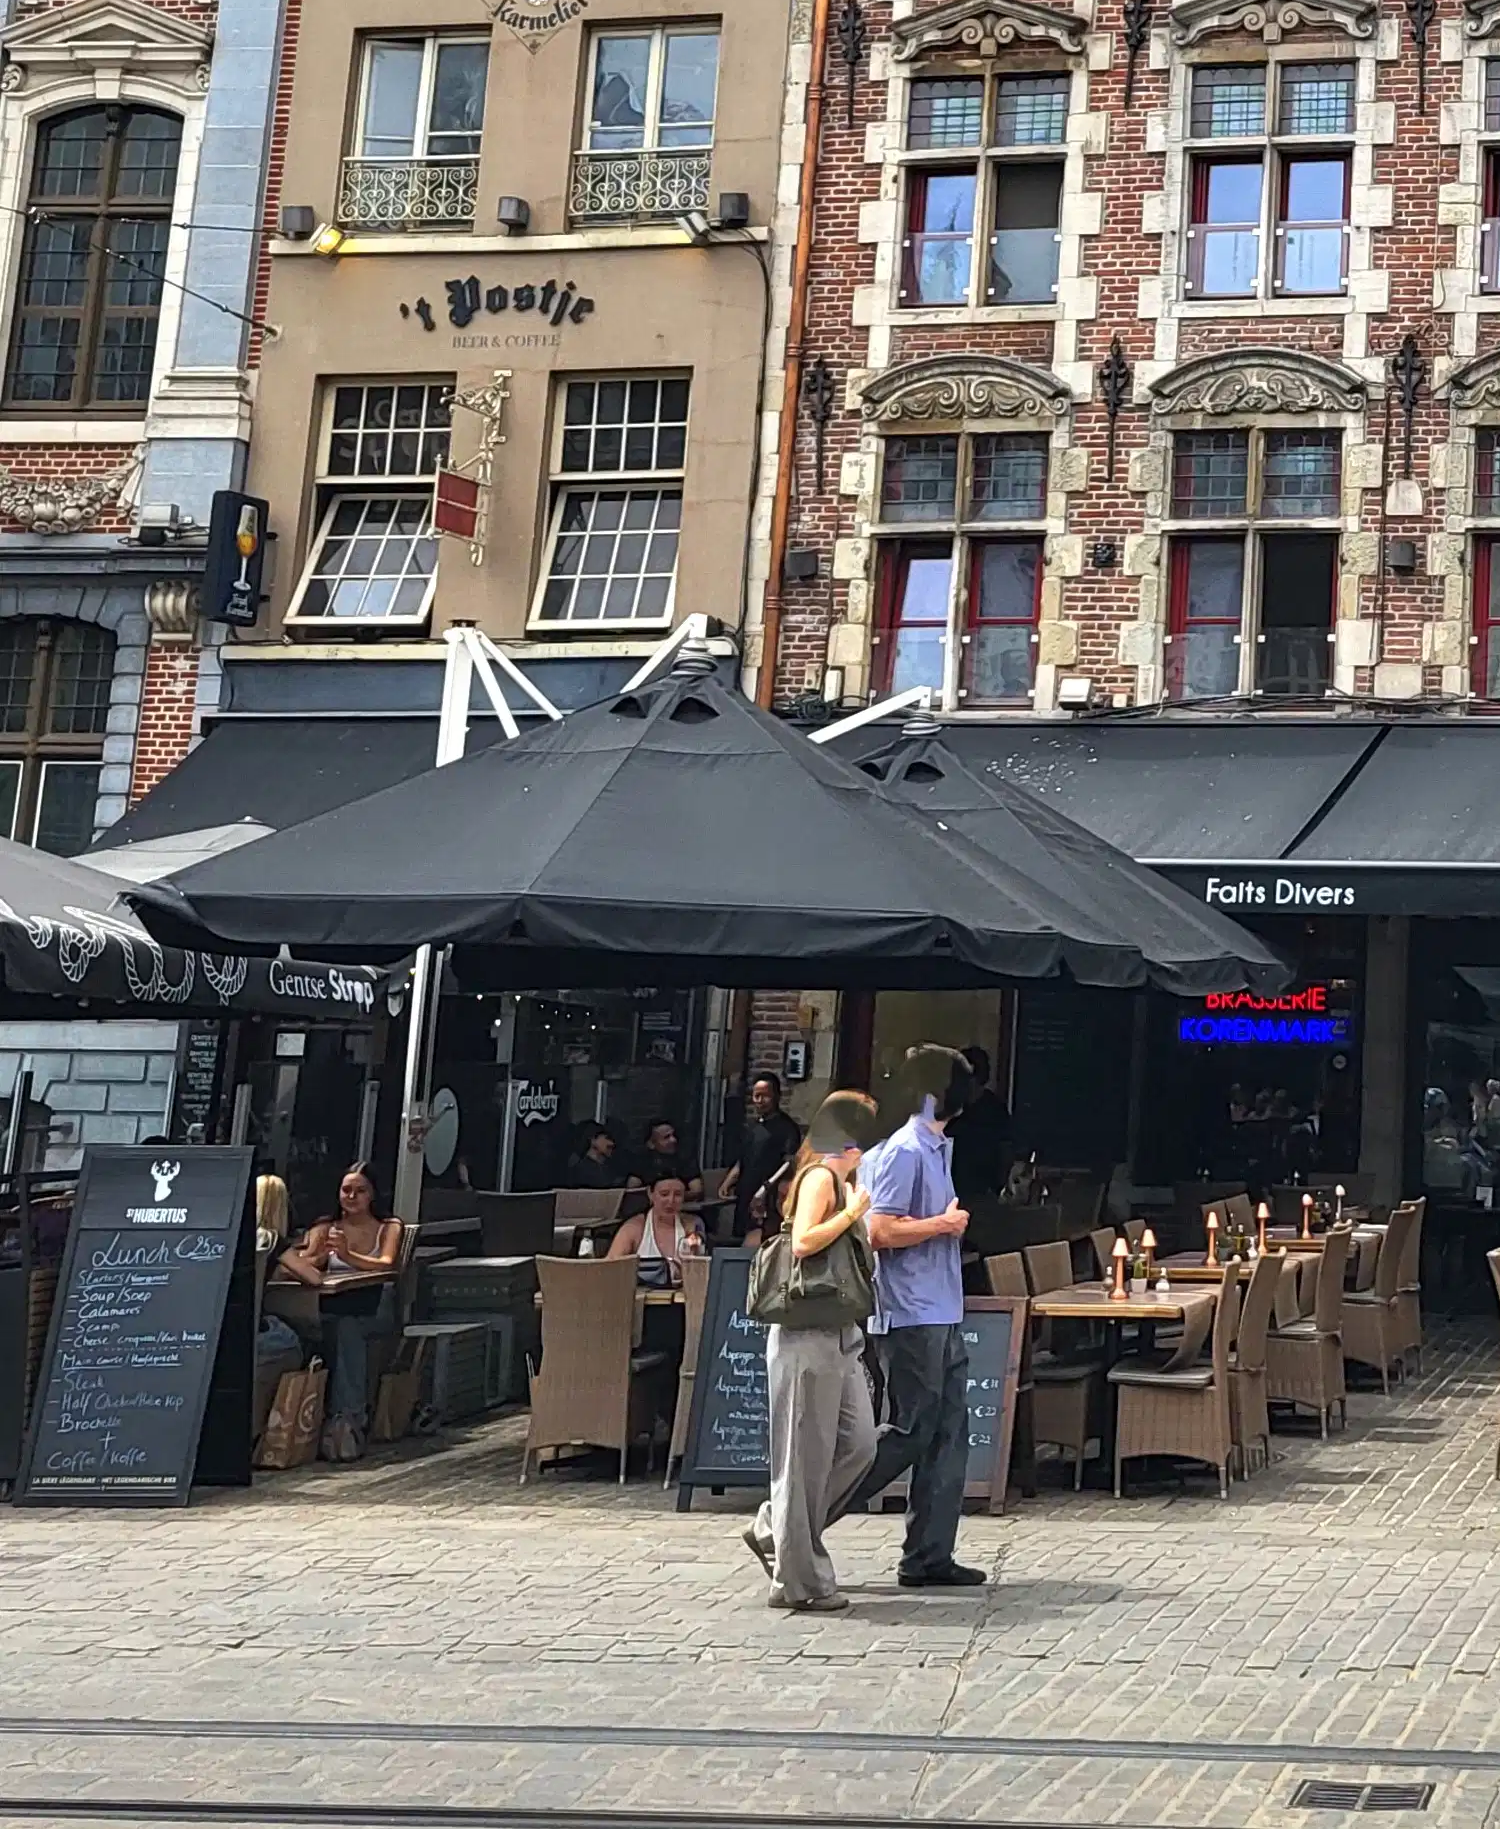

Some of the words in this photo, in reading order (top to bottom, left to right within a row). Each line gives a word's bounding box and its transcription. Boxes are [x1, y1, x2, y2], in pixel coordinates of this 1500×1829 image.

[445, 275, 595, 328] Postje
[452, 334, 489, 349] BEER
[491, 334, 501, 348] &
[505, 334, 561, 348] COFFEE
[1206, 877, 1266, 904] Faits
[1275, 878, 1355, 905] Divers
[268, 960, 328, 1000] Gentse
[328, 968, 375, 1013] Strop
[513, 1080, 560, 1117] Carlsberg
[132, 1207, 188, 1224] HUBERTUS
[92, 1232, 173, 1267] Lunch
